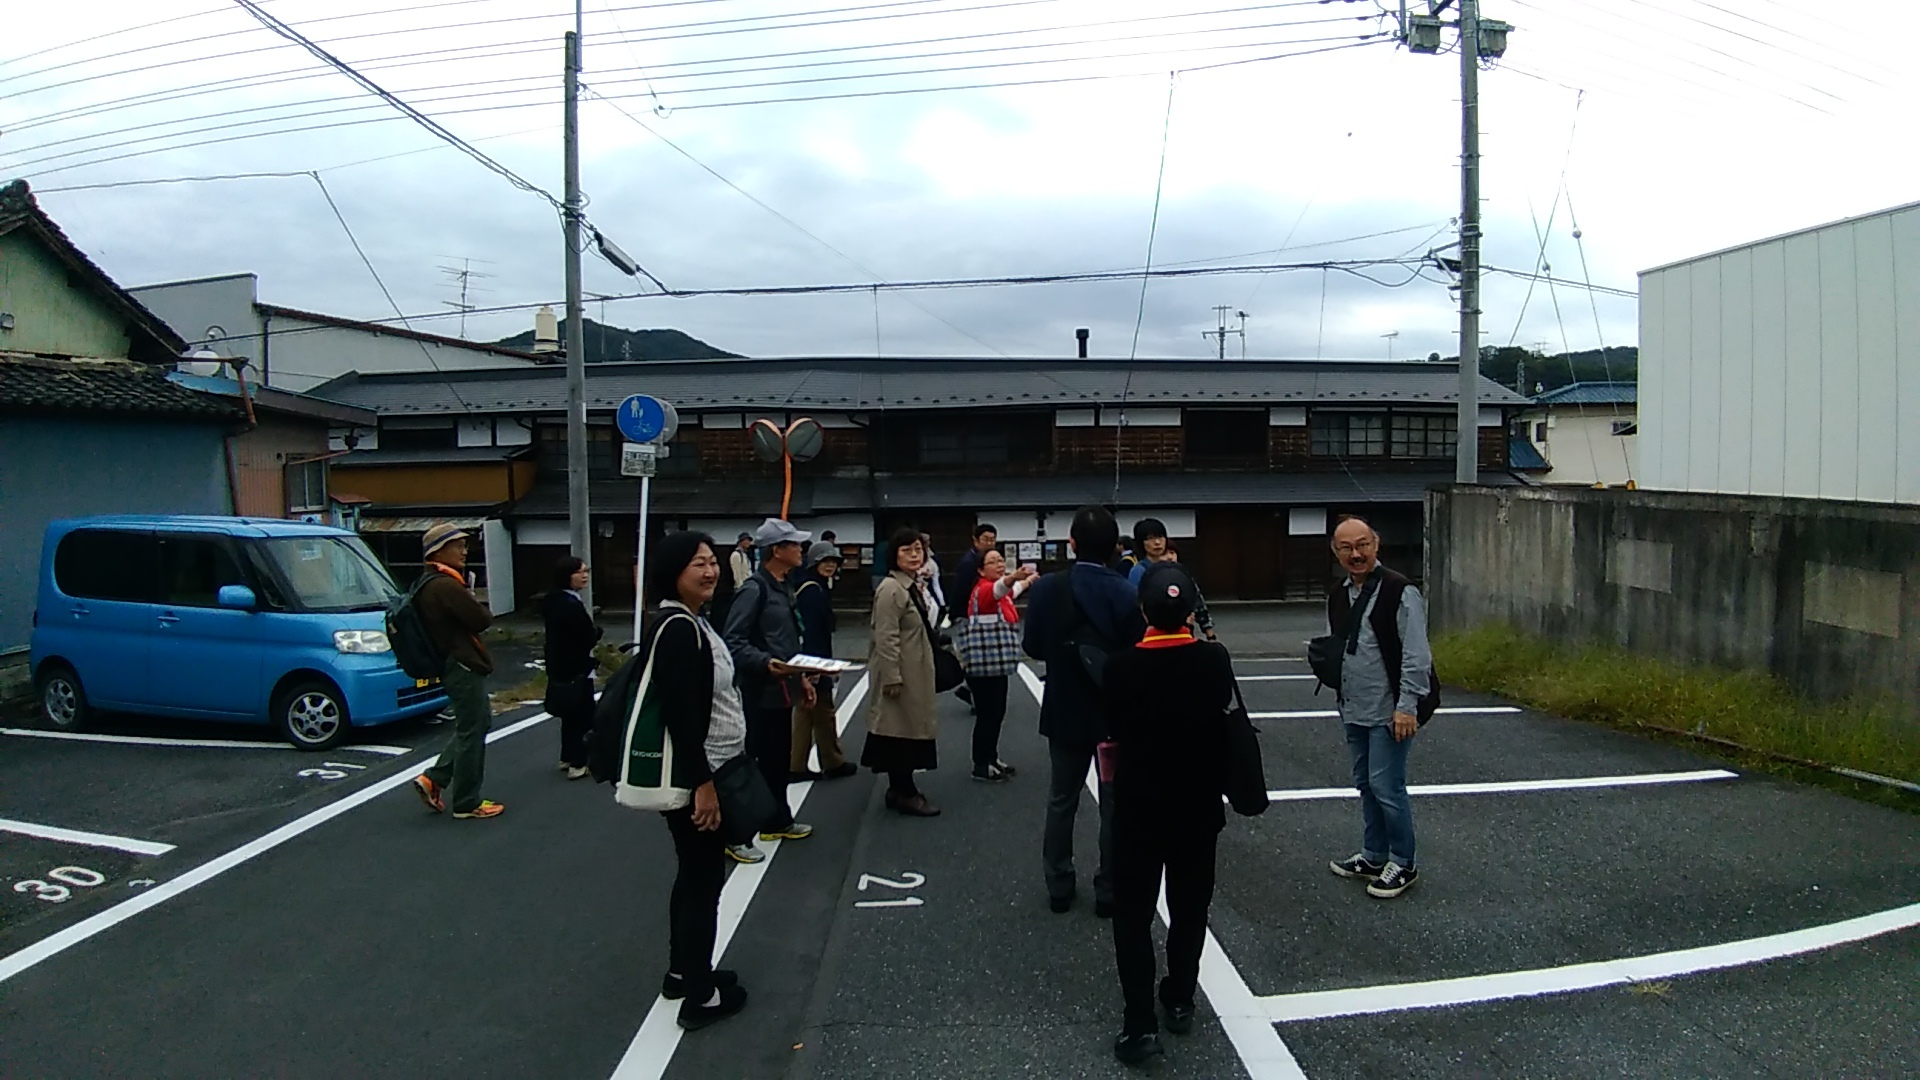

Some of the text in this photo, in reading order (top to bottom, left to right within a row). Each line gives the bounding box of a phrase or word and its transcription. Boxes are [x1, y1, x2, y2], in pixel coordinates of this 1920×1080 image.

[297, 760, 367, 781] 31
[12, 865, 106, 904] 30
[854, 871, 927, 909] 21
